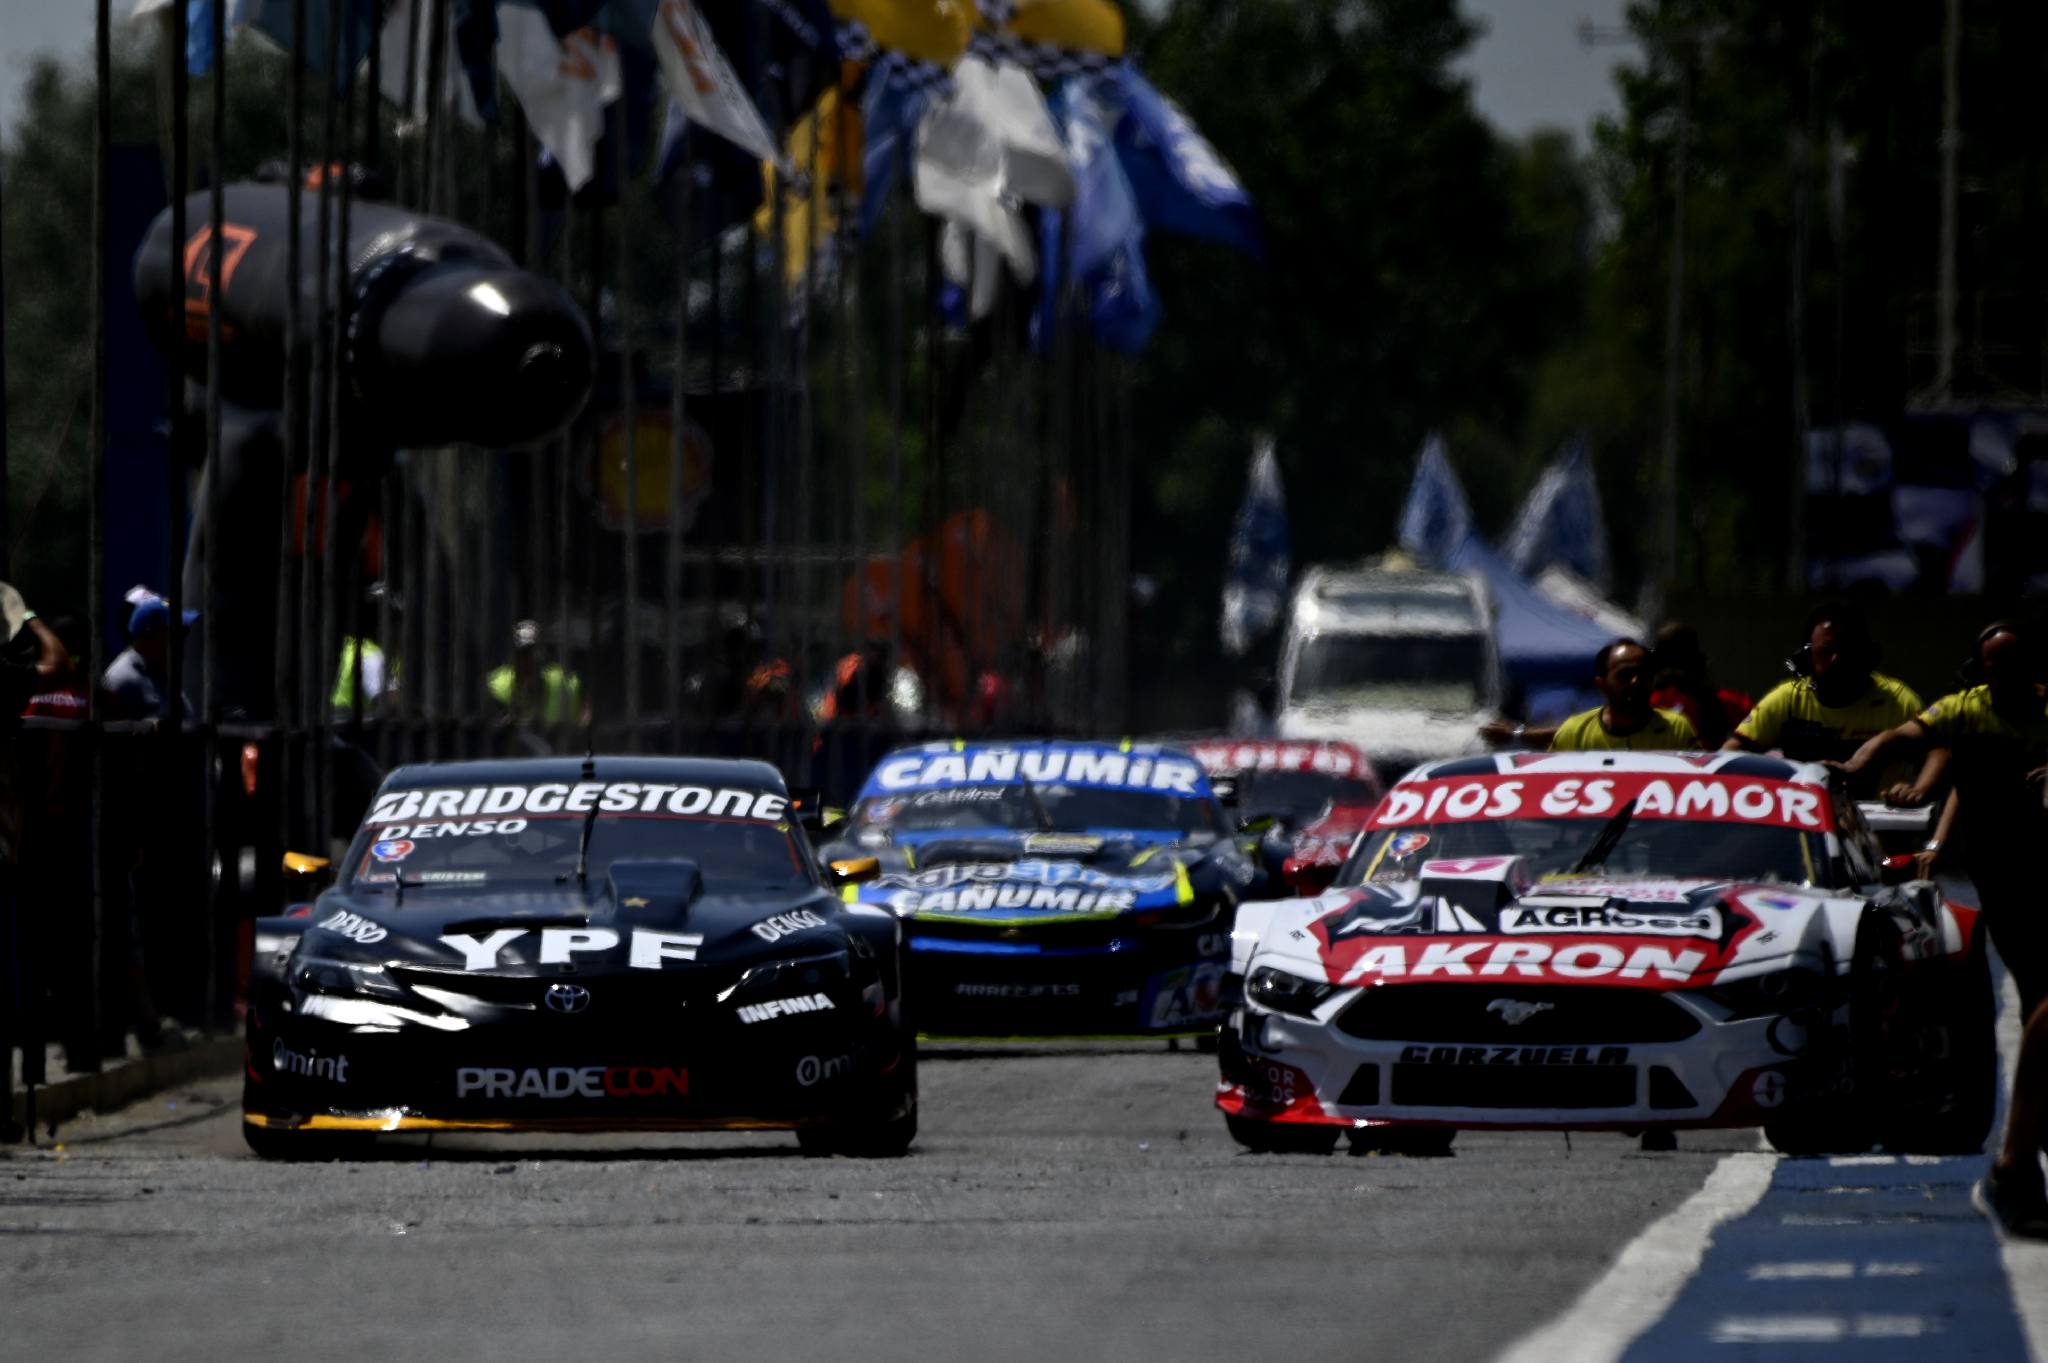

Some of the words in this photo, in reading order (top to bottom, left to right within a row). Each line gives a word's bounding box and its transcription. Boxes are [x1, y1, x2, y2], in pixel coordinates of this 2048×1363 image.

[365, 781, 790, 825] BRIDGESTONE
[1377, 781, 1525, 826] DIOS
[1540, 779, 1615, 816] ES
[1633, 779, 1822, 827] AMOR
[378, 818, 528, 841] DENSO
[319, 910, 389, 944] DENSO
[751, 909, 828, 944] DENSO
[437, 925, 705, 971] YPF
[1339, 941, 1707, 987] AKRON
[736, 993, 837, 1025] INFINIA
[456, 1065, 690, 1100] PRADECON
